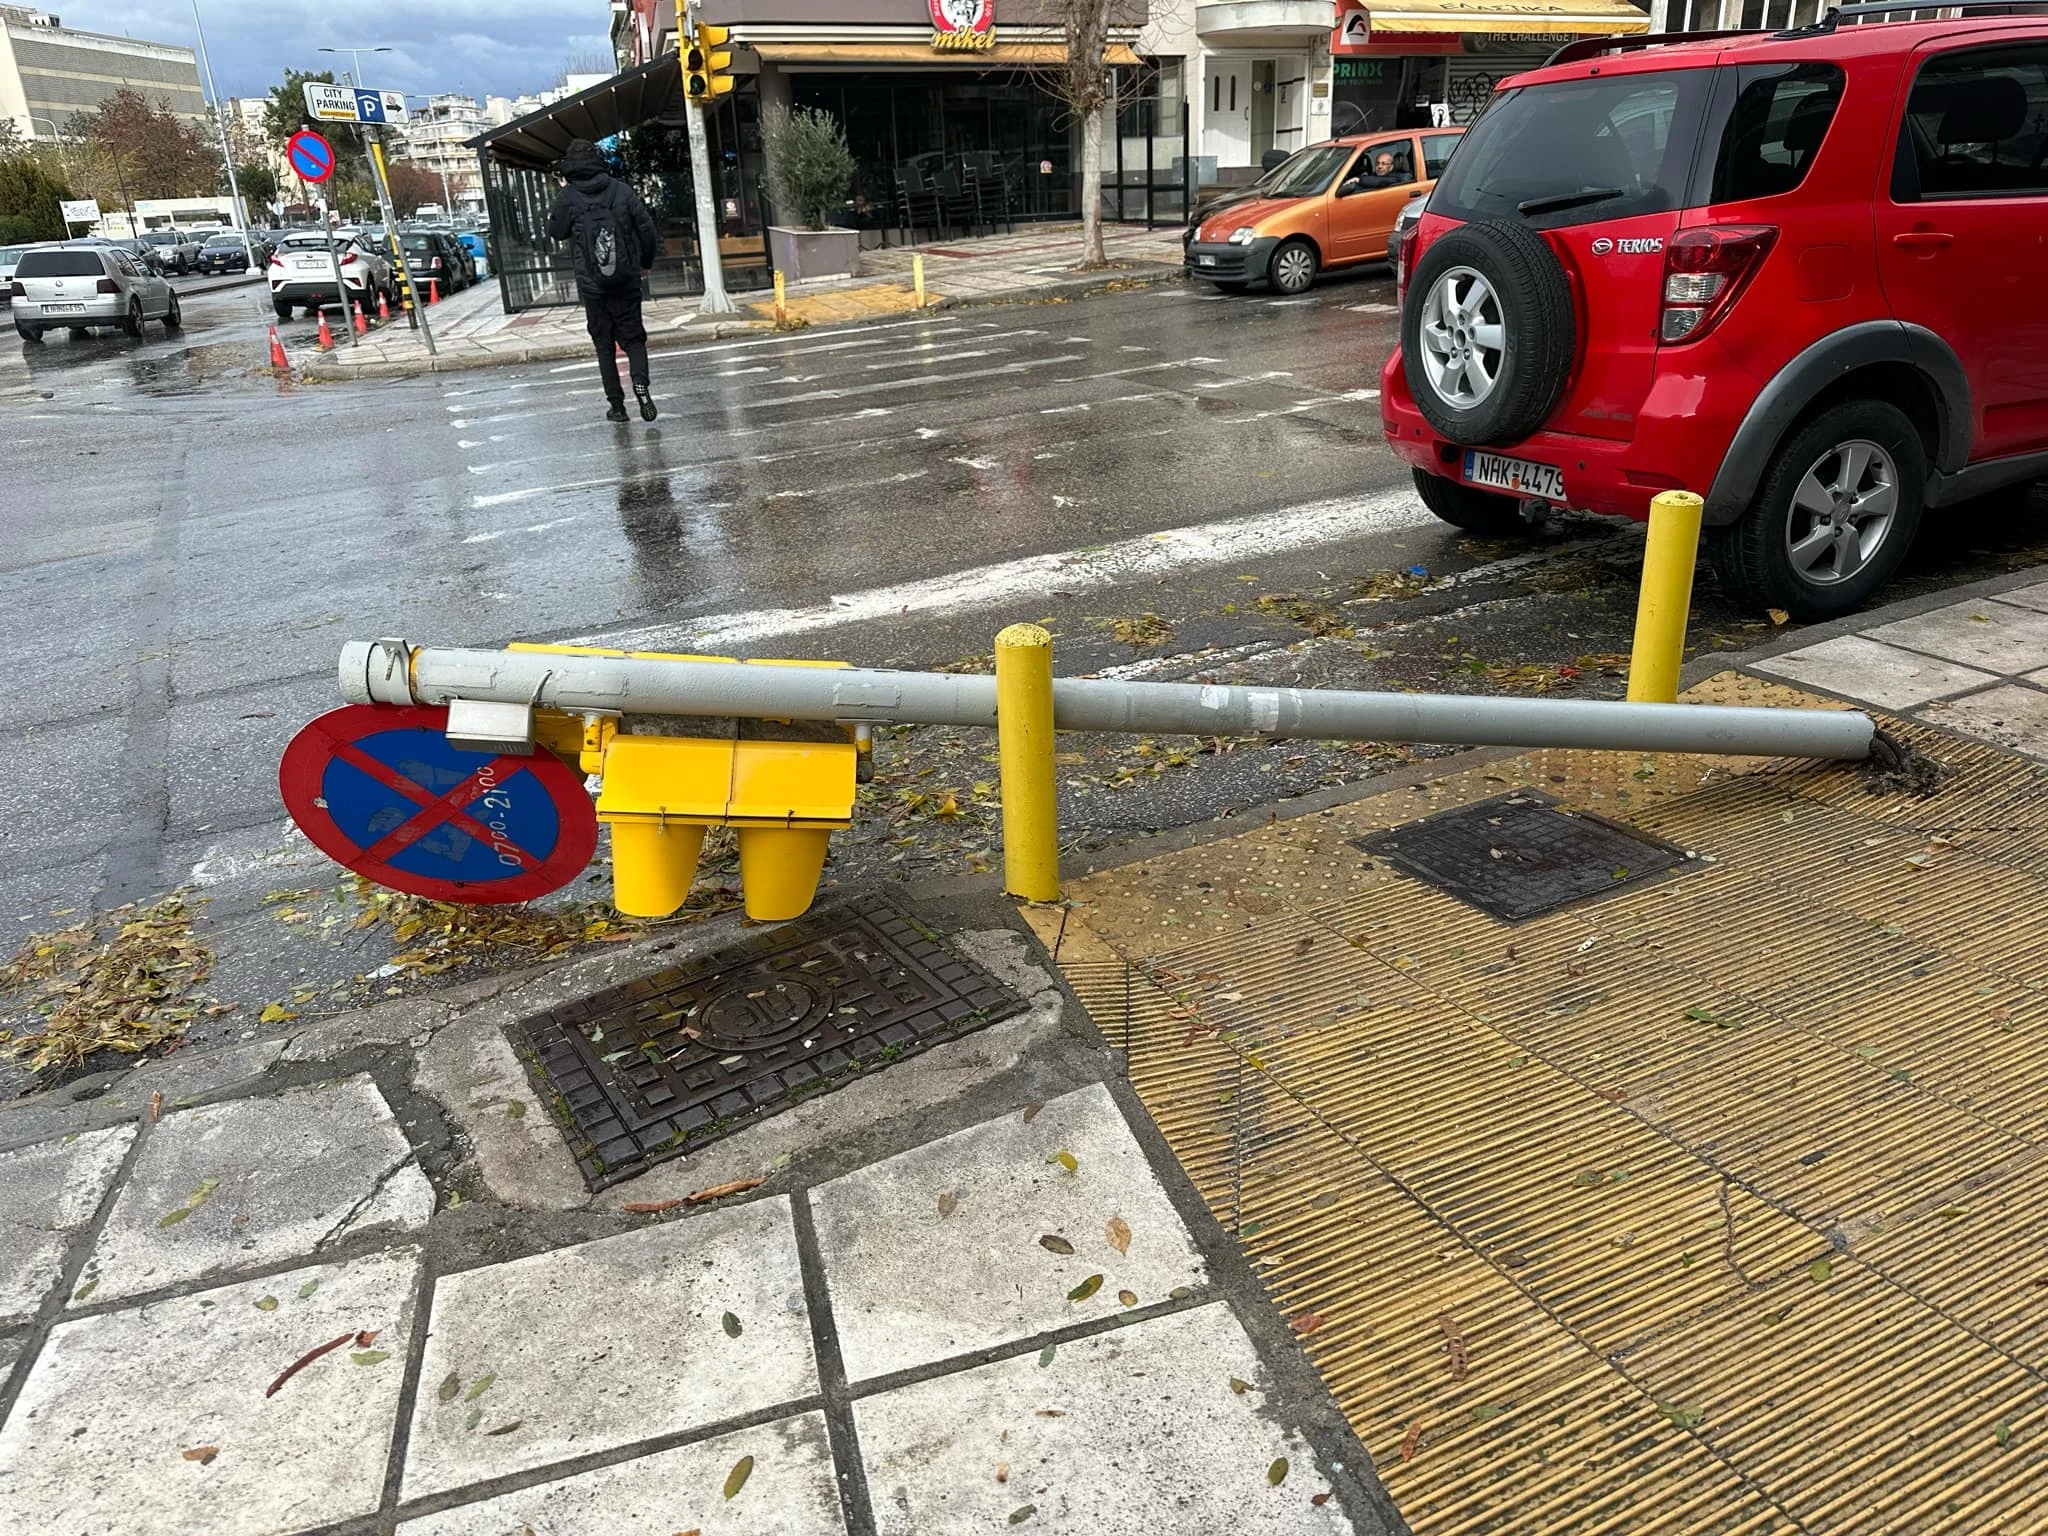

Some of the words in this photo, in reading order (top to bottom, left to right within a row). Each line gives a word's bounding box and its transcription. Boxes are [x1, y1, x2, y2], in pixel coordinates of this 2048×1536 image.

[1439, 2, 1566, 12] ΕΛΑΣΤΙΚΑ
[931, 25, 997, 49] mikel
[1488, 32, 1507, 42] THE
[1510, 32, 1569, 42] CHALLENGE
[1334, 62, 1384, 77] PRINX
[323, 88, 342, 98] CITY
[316, 98, 355, 111] PARKING
[364, 100, 376, 117] P
[1616, 237, 1663, 254] TERIOS
